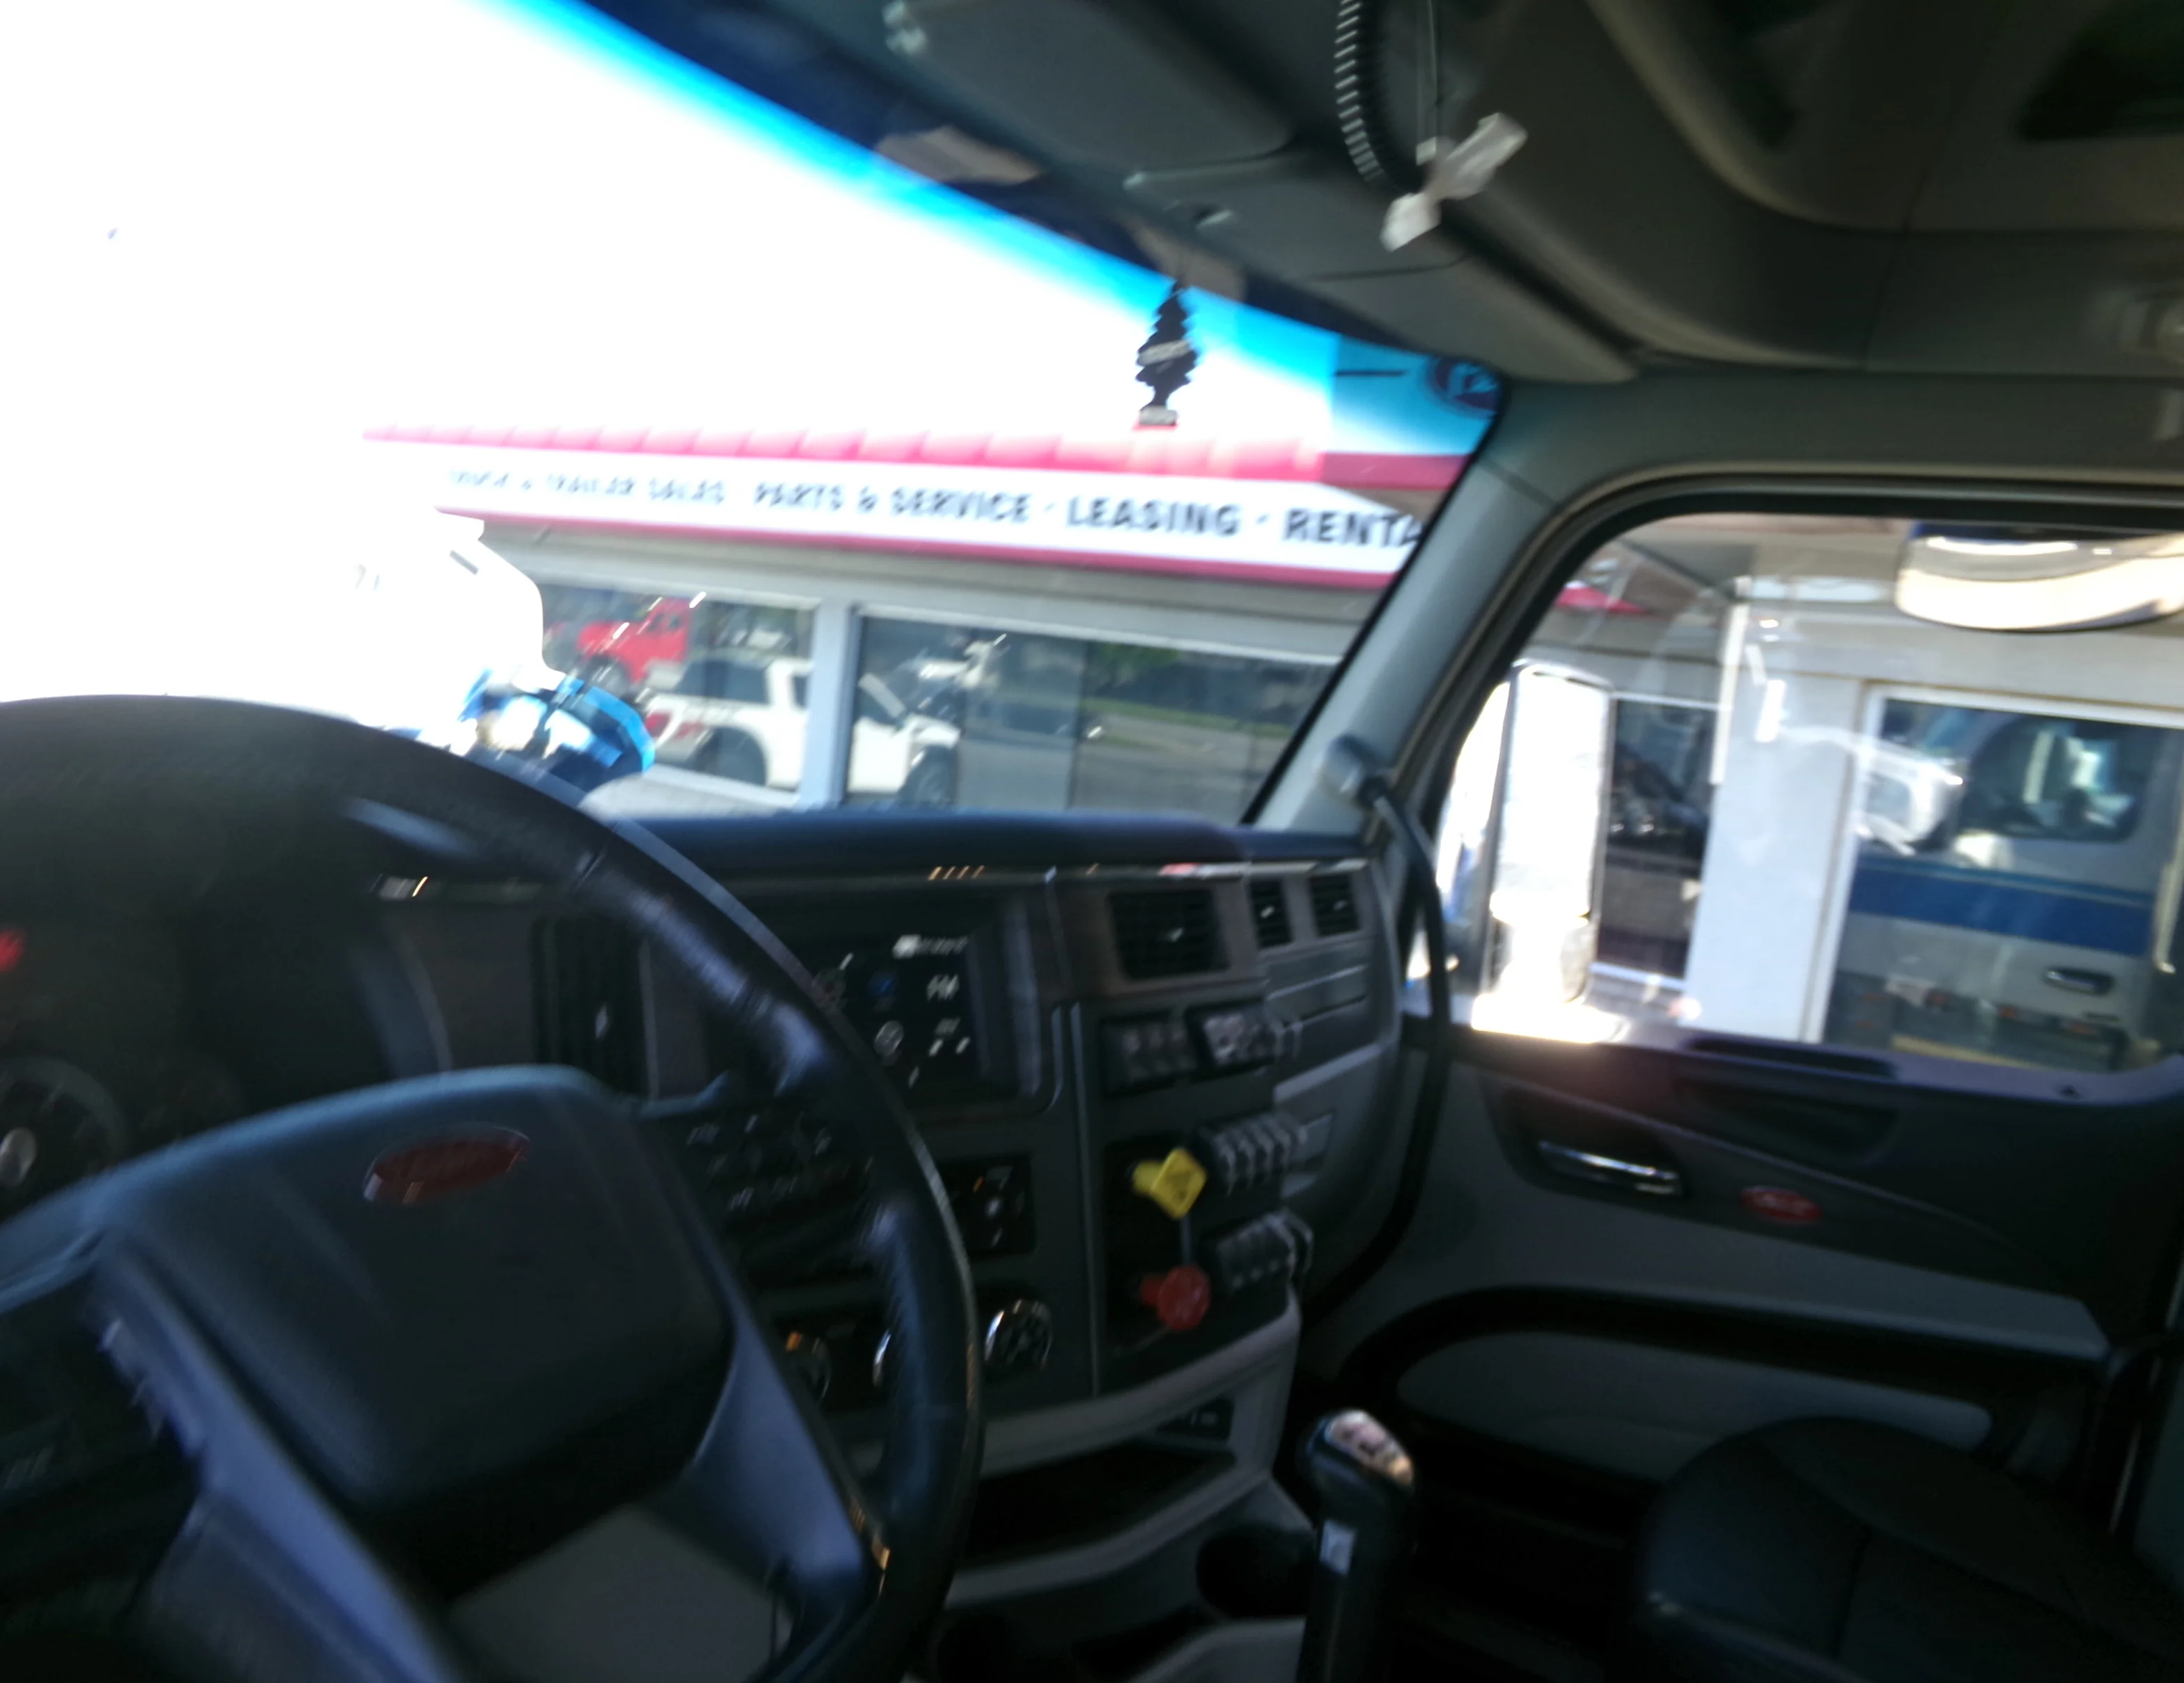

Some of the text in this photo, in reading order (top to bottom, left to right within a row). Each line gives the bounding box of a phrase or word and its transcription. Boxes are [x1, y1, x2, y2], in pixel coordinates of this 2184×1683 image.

[754, 481, 844, 512] PARTS
[857, 485, 879, 513] &
[889, 486, 1031, 525] SERVICE
[1066, 494, 1240, 538] LEASING
